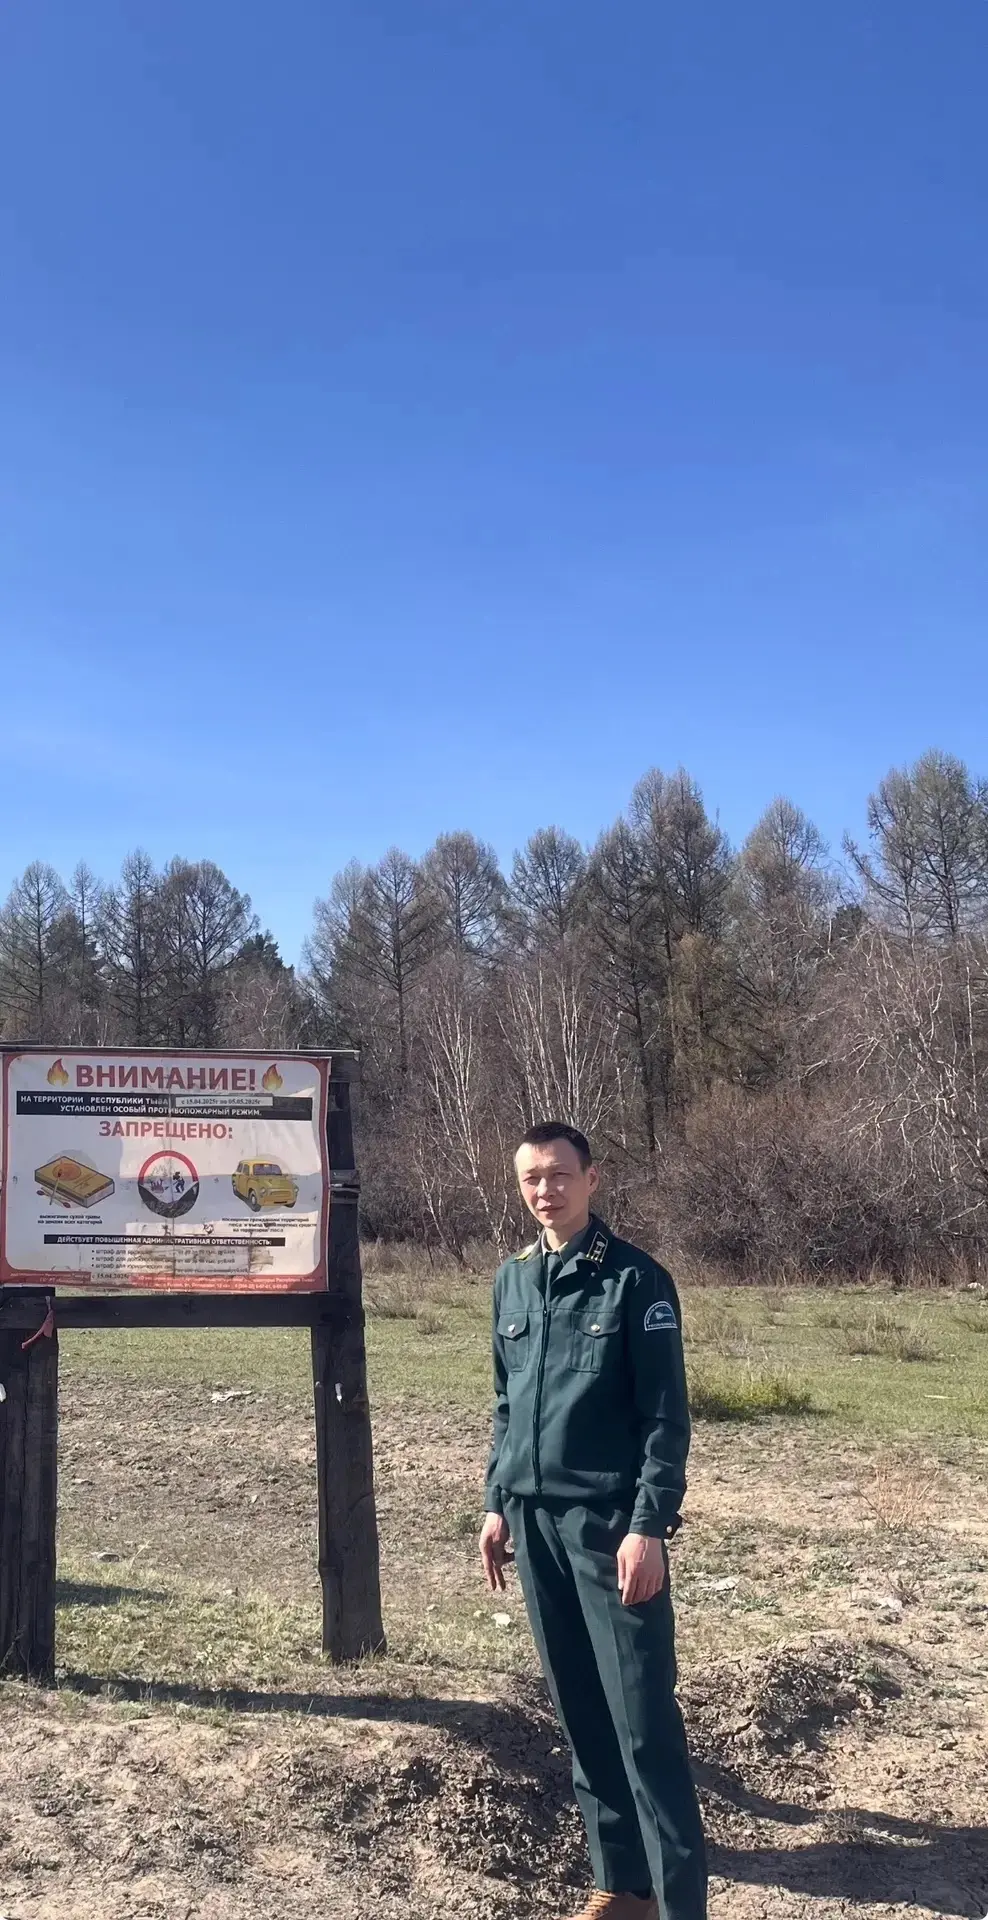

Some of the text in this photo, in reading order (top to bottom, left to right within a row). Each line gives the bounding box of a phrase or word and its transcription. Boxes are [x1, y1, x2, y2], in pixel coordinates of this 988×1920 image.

[76, 1064, 256, 1091] ВНИМАНИЕ!
[21, 1095, 31, 1103] НА
[33, 1095, 84, 1103] ТЕРРИТОРИИ
[90, 1097, 144, 1105] РЕСПУБЛИКИ
[60, 1104, 262, 1116] УСТАНОВЛЕН ОСОБЫЙ ПРОТИВОПОЖАРНЫЙ РЕЖИМ.
[99, 1120, 233, 1141] ЗАПРЕЩЕНО:
